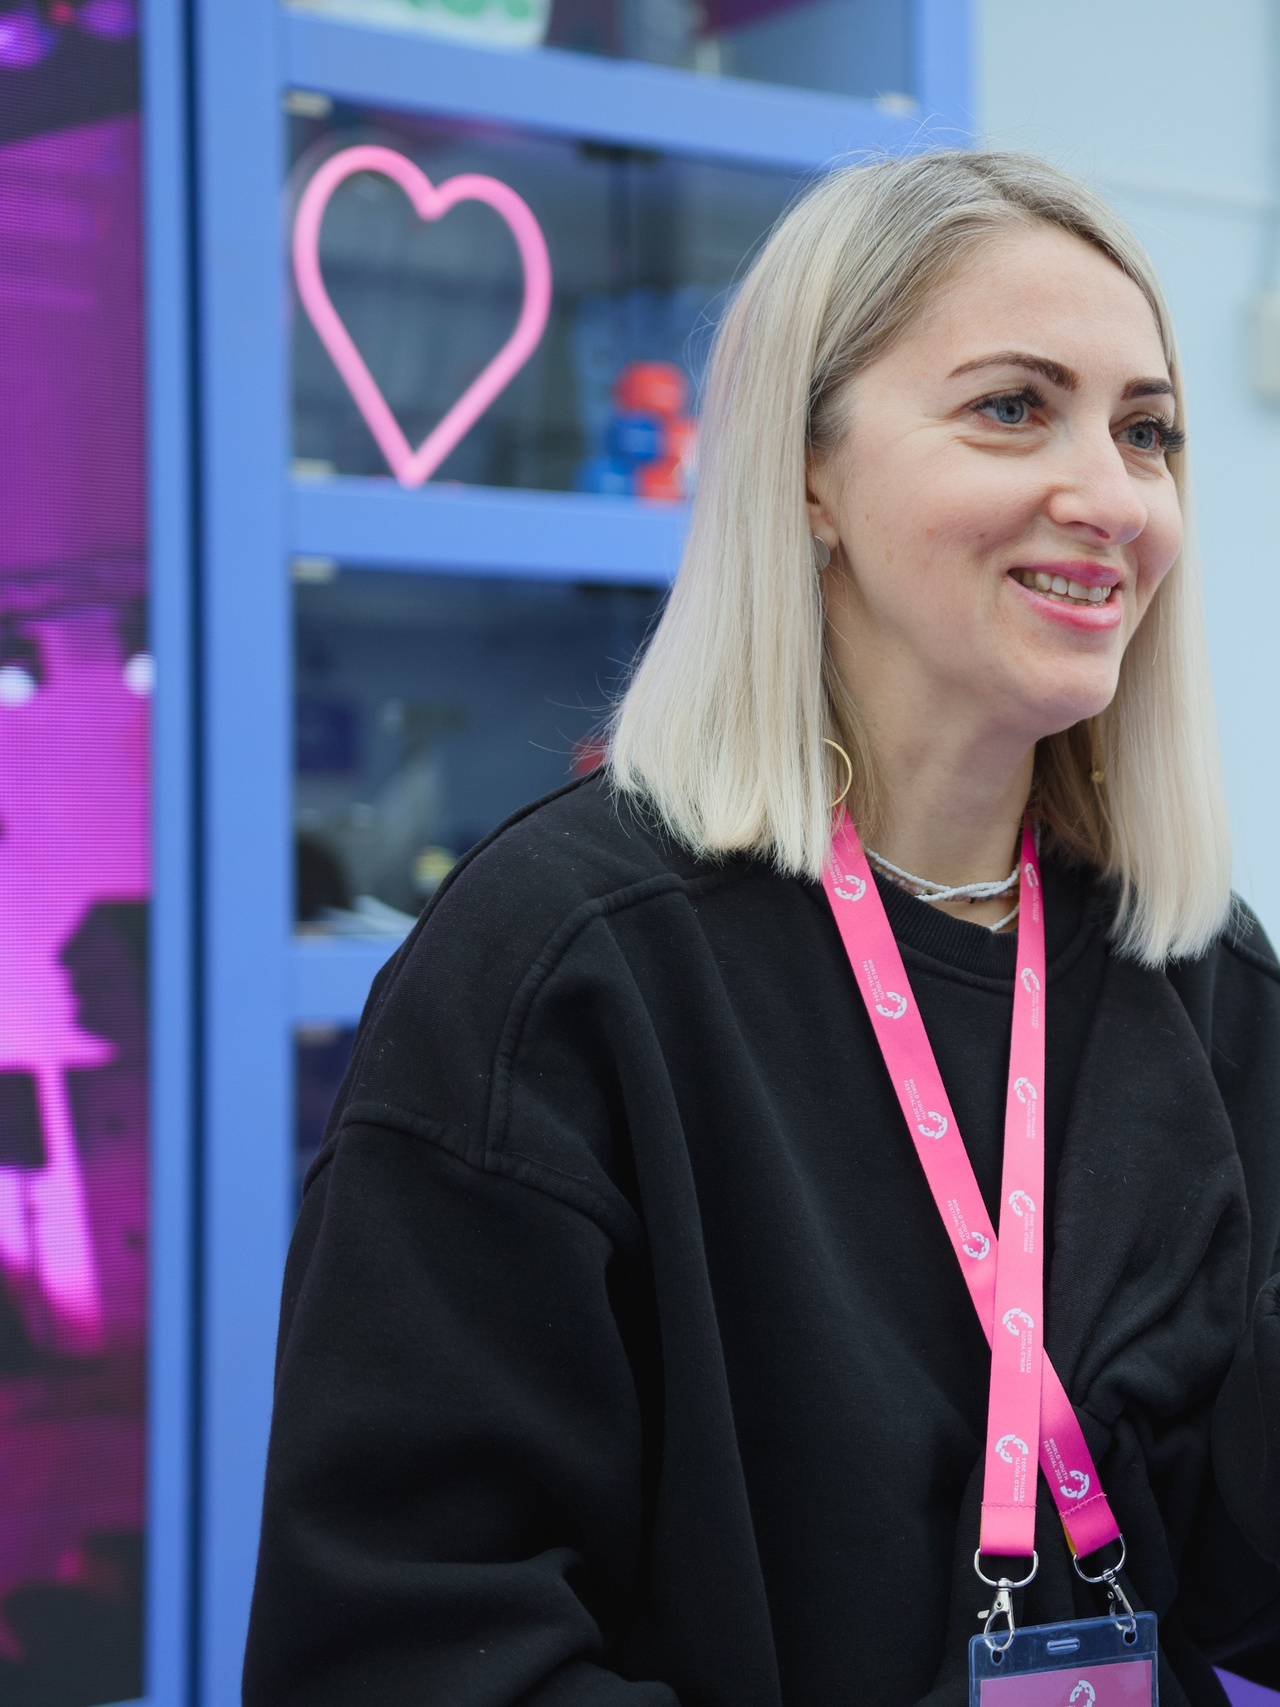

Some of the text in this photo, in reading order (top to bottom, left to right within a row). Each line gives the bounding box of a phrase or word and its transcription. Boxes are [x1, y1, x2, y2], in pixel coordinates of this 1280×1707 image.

[834, 864, 845, 884] YOUTH
[862, 960, 880, 1002] FESTIVAL 2024
[868, 959, 886, 1001] WORLD YOUTH
[903, 1080, 922, 1122] FESTIVAL 2024
[909, 1078, 927, 1120] WORLD YOUTH
[947, 1200, 966, 1242] FESTIVAL 2024
[952, 1198, 971, 1240] WORLD YOUTH
[1043, 1440, 1064, 1484] FESTIVAL 2024
[1049, 1437, 1069, 1480] WORLD YOUTH
